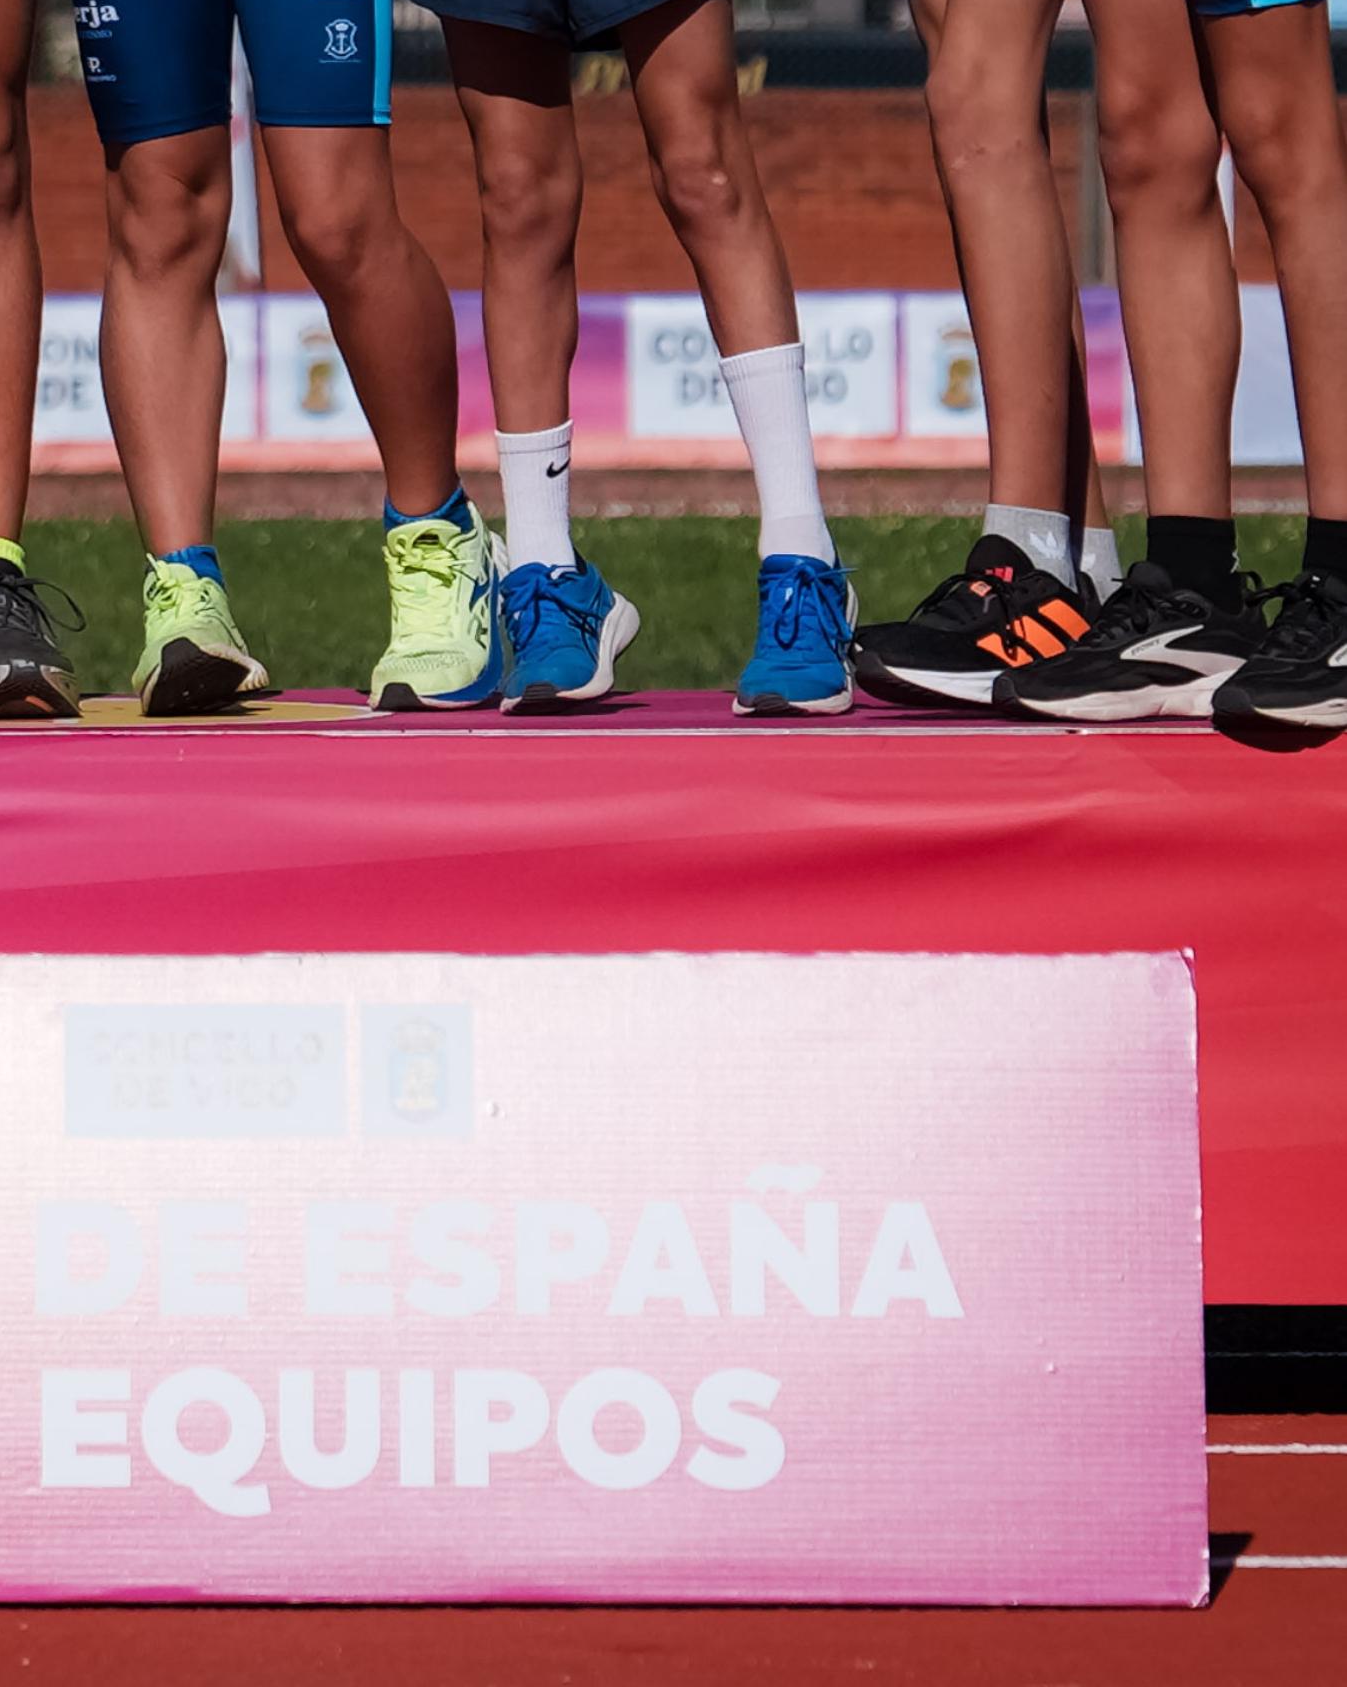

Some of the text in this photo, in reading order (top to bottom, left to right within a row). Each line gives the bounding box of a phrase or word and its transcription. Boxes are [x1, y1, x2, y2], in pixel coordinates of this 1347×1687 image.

[34, 1199, 251, 1317] DE
[304, 1163, 965, 1320] ESPAÑA
[40, 1366, 788, 1517] EQUIPOS
